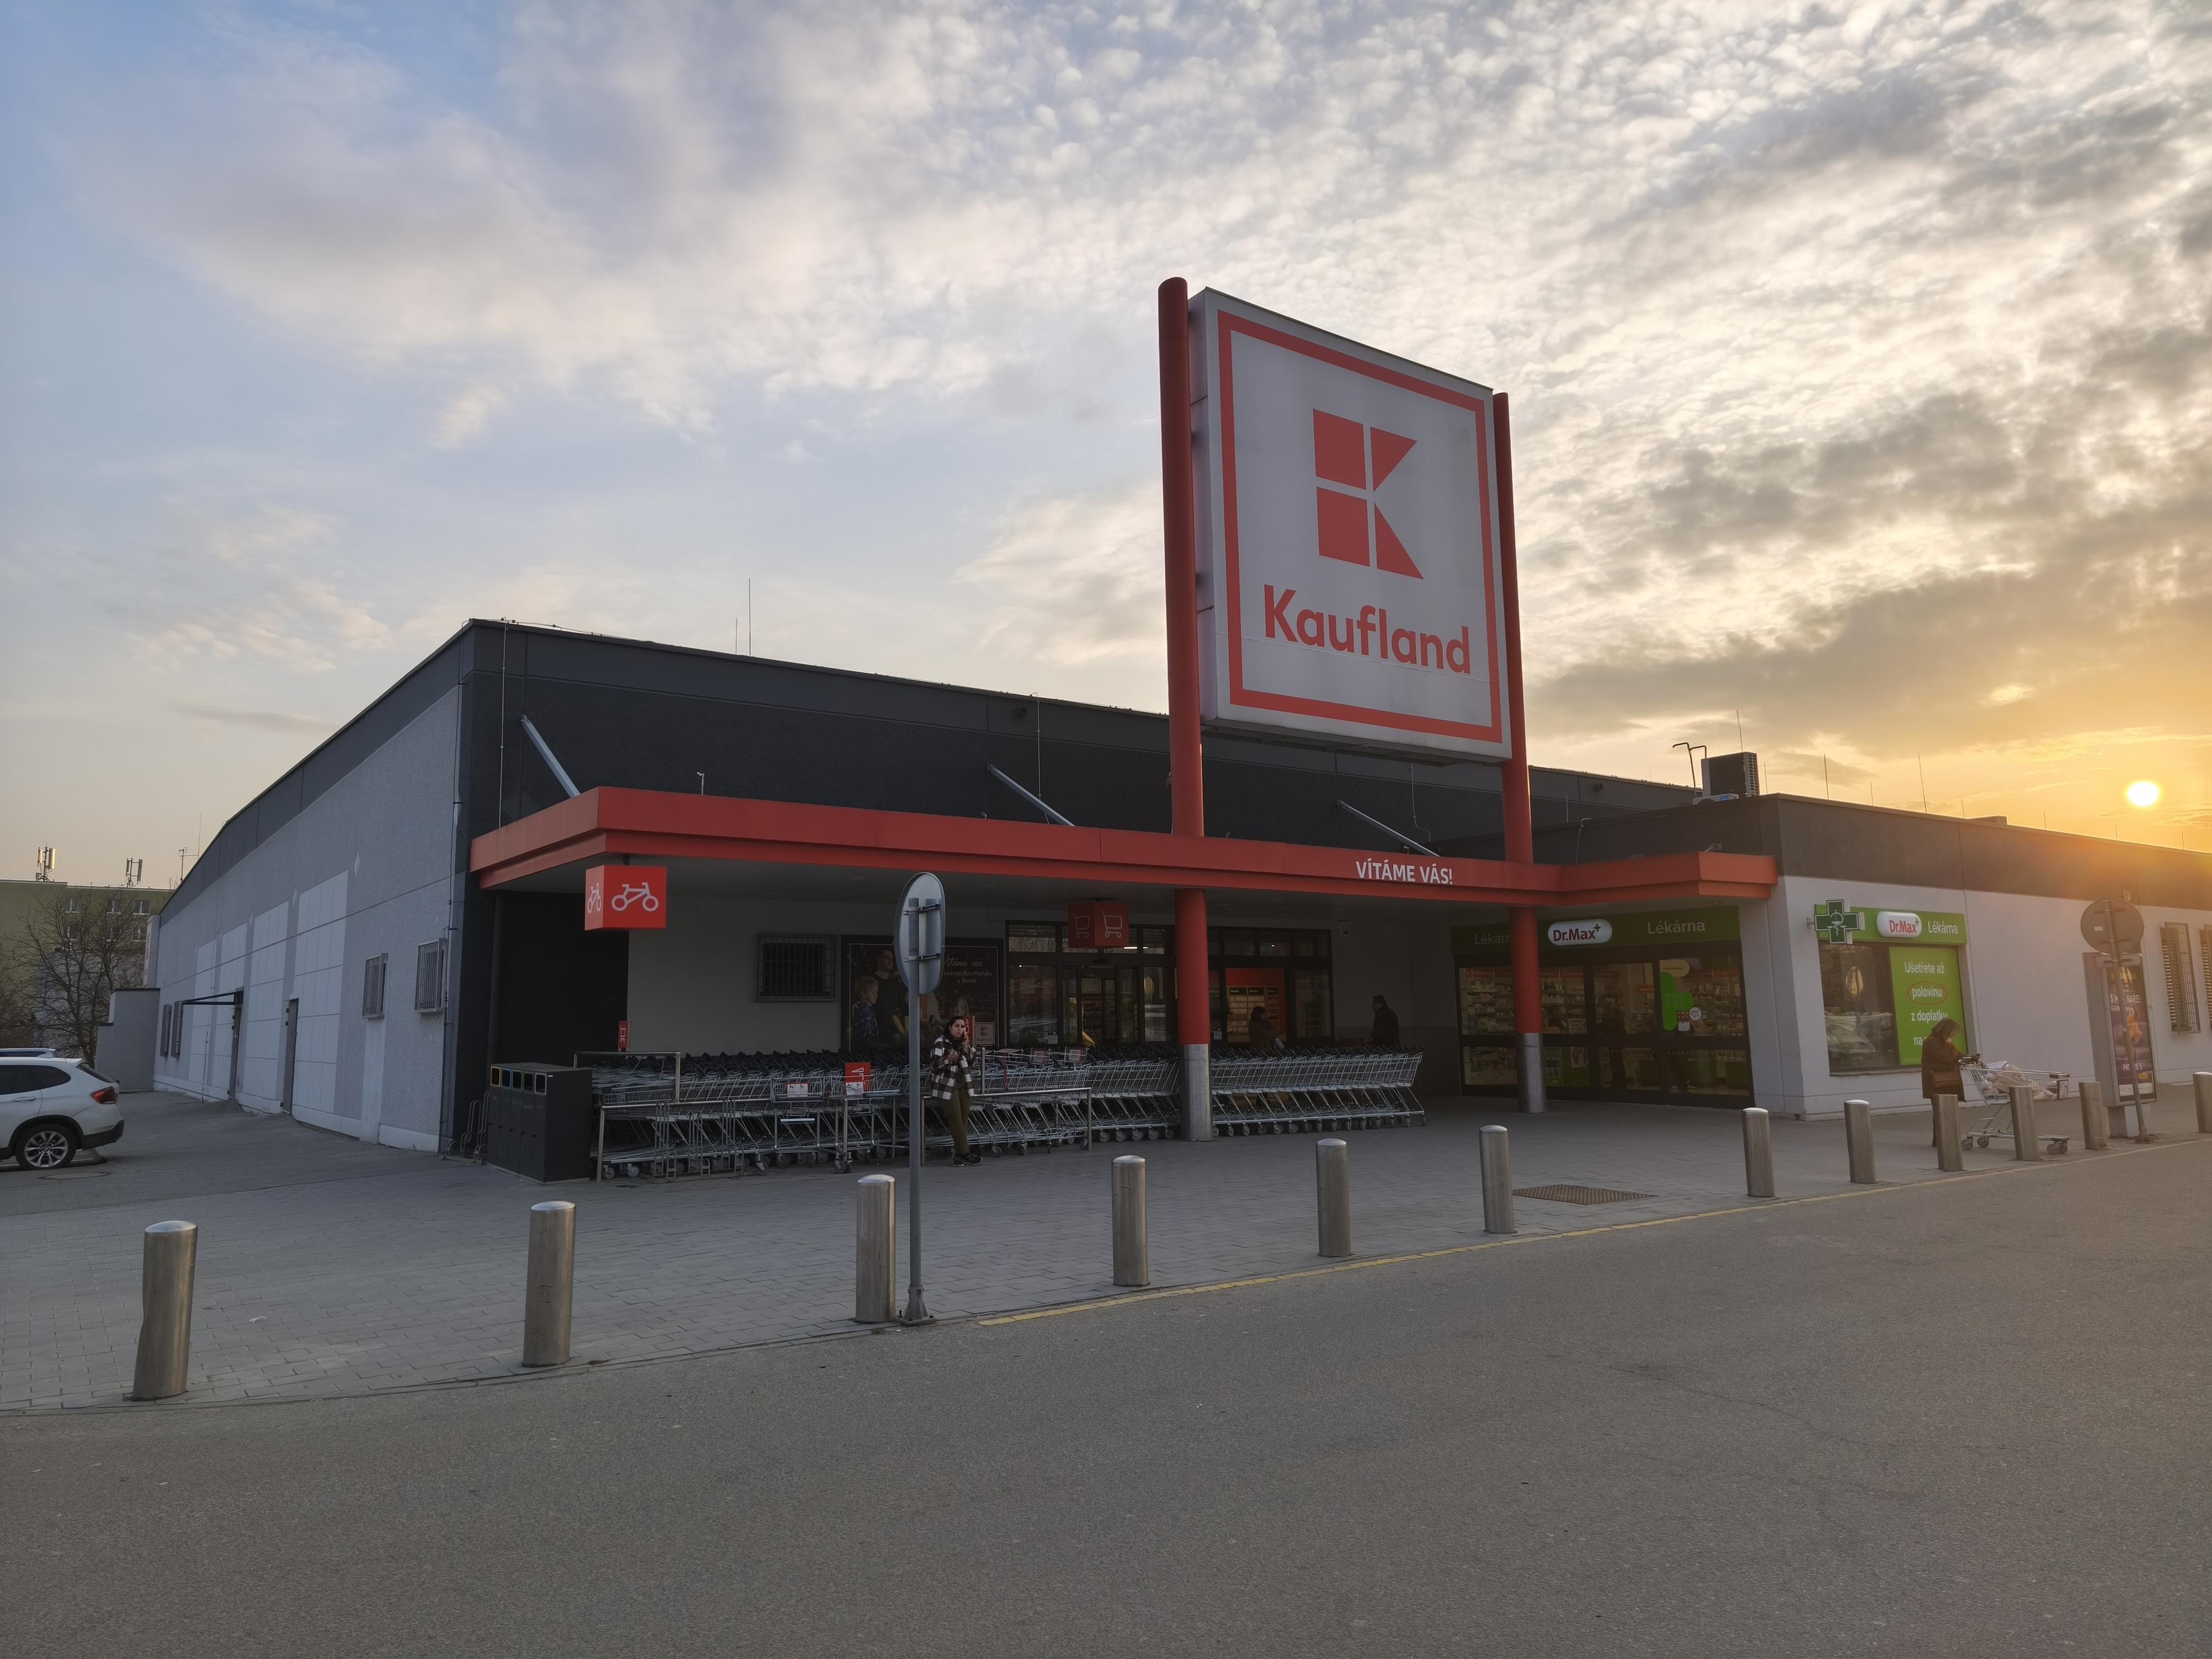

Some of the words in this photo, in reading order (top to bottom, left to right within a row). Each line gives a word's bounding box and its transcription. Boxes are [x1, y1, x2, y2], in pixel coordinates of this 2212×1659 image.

[1264, 584, 1471, 674] Kaufland
[1356, 858, 1416, 882] VÍTÁME
[1420, 863, 1453, 885] VÁS!
[1647, 920, 1705, 935] Lékárna
[1928, 921, 1958, 934] Lékárna
[1474, 931, 1510, 946] Lékárn
[1905, 961, 1935, 973] Ušetřete
[1937, 963, 1945, 973] až
[1912, 987, 1943, 1000] polovinu
[1911, 1013, 1916, 1021] z
[1914, 1037, 1922, 1046] na
